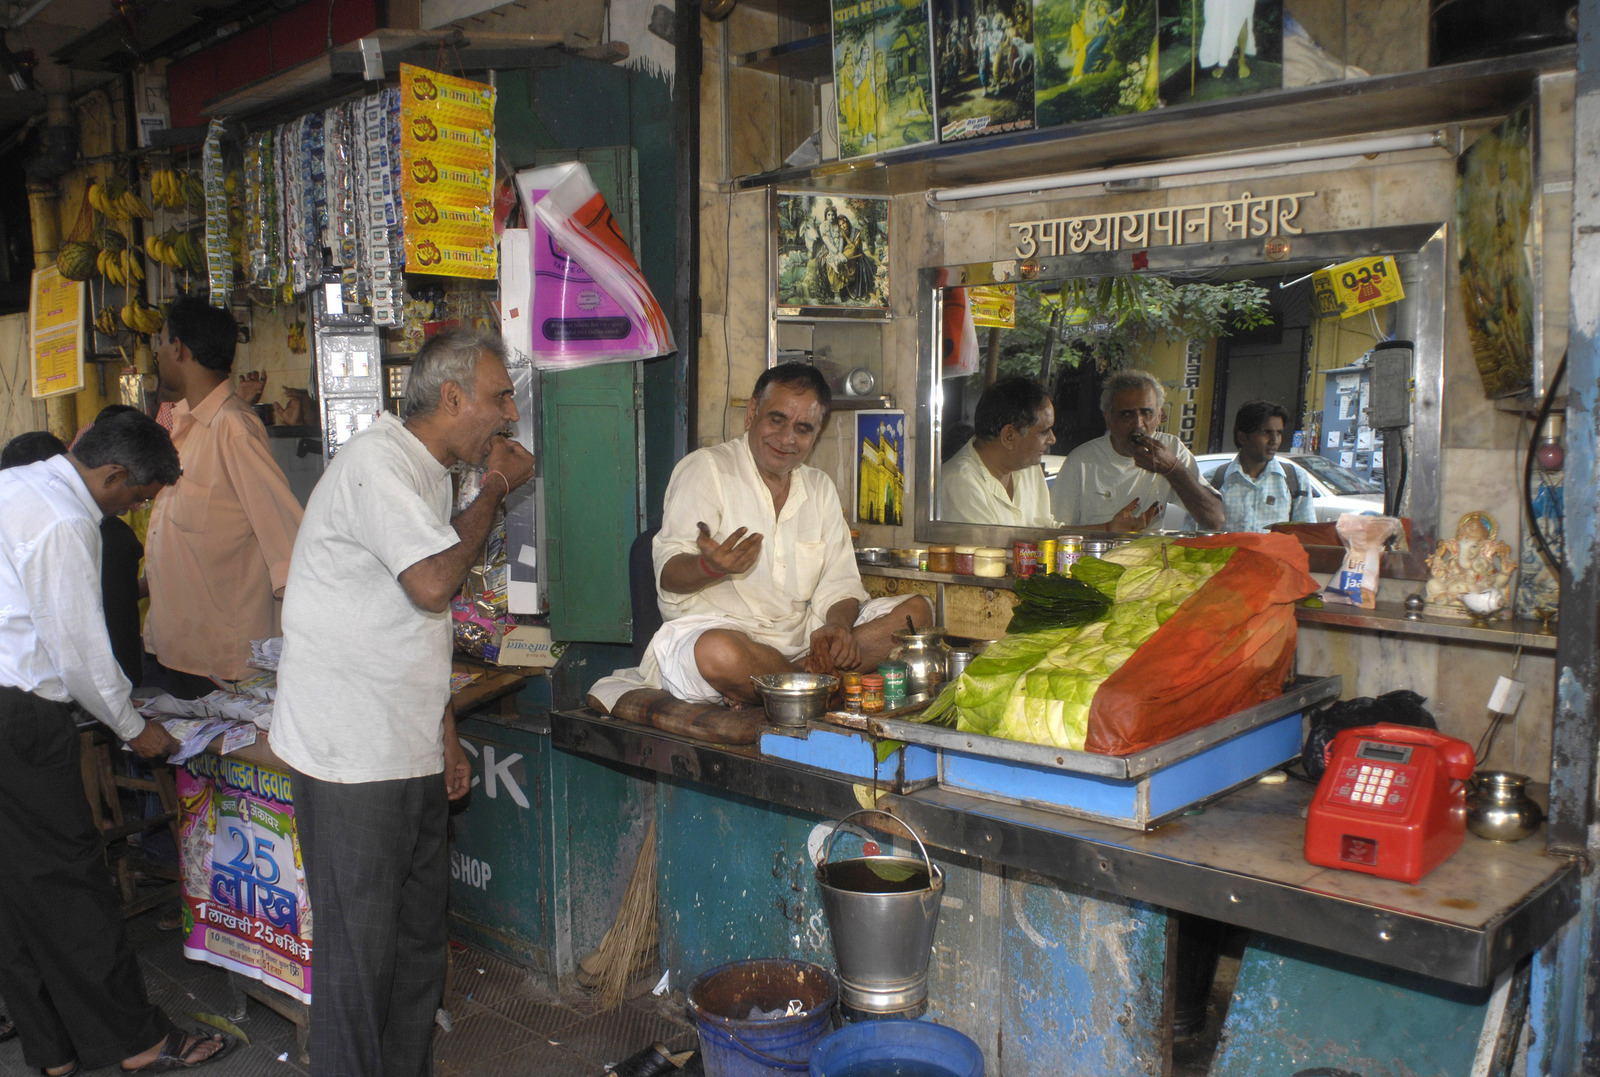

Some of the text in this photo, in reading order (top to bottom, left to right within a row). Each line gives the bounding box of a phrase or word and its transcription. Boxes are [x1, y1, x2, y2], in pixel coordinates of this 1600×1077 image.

[1222, 191, 1315, 239] भंडार
[238, 797, 250, 821] 4
[228, 826, 281, 884] 25
[451, 850, 492, 891] SHOP
[210, 860, 298, 937] लाख
[195, 902, 207, 919] 1
[254, 921, 274, 944] 25
[210, 931, 220, 942] 10
[262, 959, 270, 970] 51
